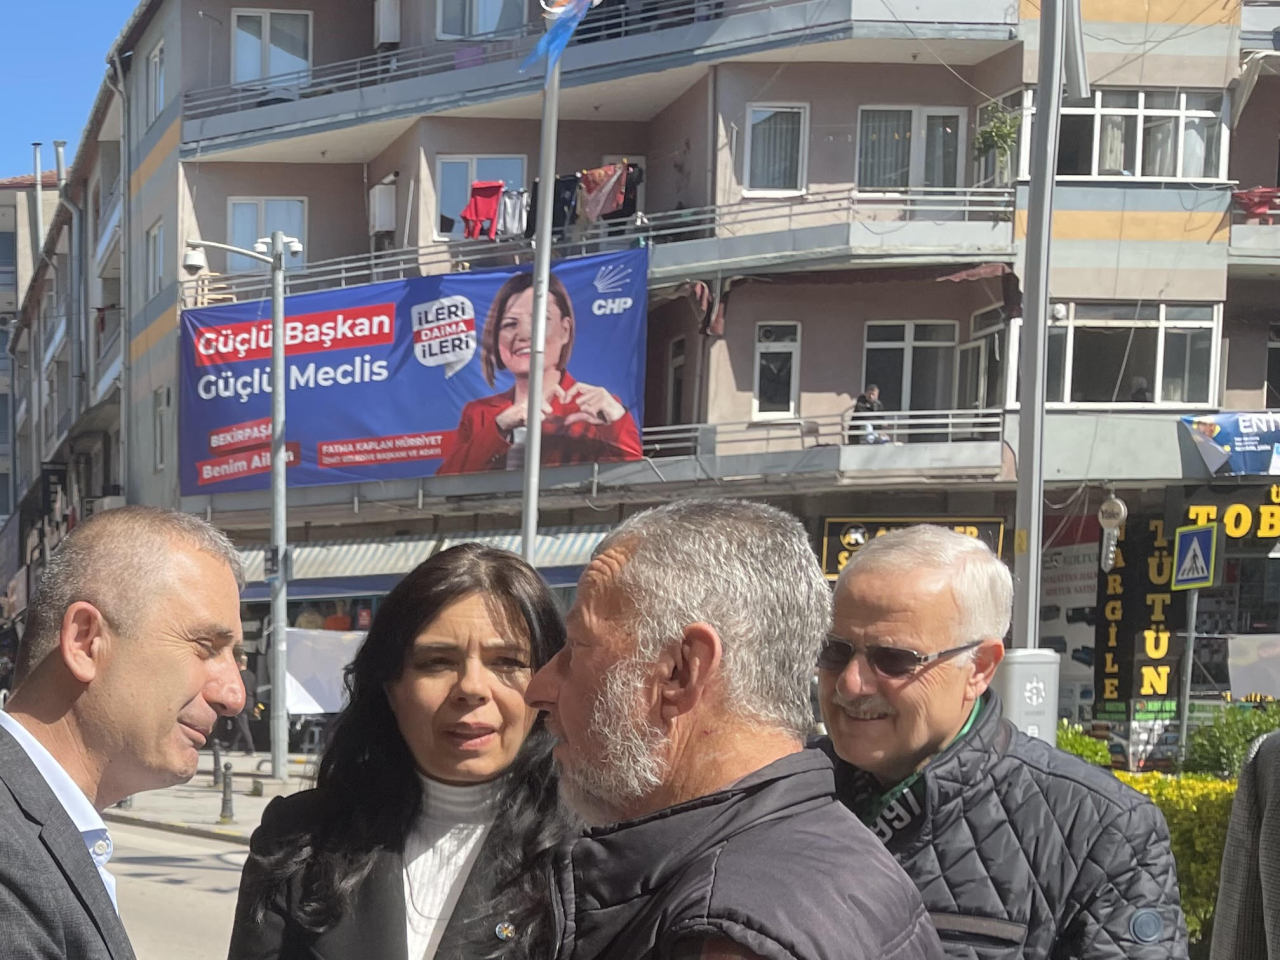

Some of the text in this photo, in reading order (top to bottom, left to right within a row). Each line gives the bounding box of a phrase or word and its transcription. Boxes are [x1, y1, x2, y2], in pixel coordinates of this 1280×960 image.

[592, 297, 633, 315] CHP
[198, 314, 390, 357] Güçlü Başkan
[289, 354, 388, 390] Meclis
[202, 460, 247, 479] Benim
